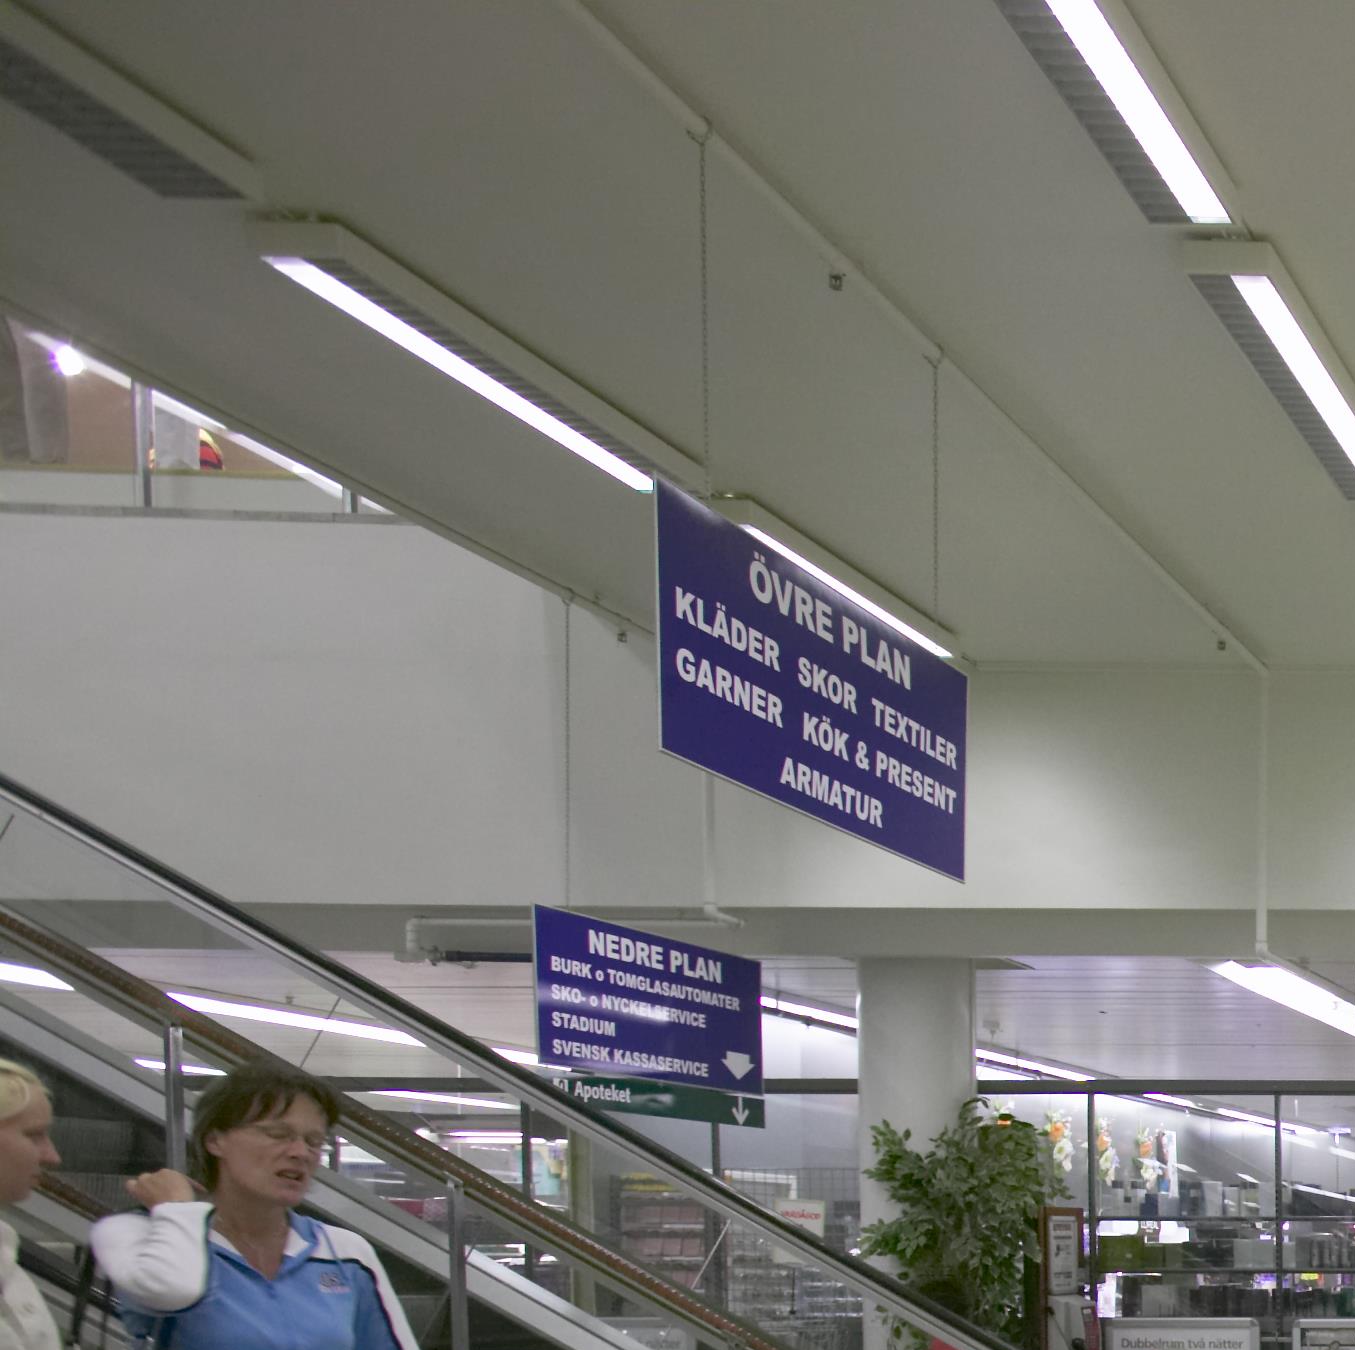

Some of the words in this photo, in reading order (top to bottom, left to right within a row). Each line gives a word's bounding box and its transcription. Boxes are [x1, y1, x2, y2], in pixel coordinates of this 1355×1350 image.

[750, 552, 834, 644] ÖVRE
[842, 616, 912, 690] PLAN
[675, 586, 781, 672] KLÄDER
[798, 657, 858, 714] SKOR
[871, 697, 957, 770] TEXTILER
[675, 647, 783, 728] GARNER
[803, 711, 849, 763] KÖK
[855, 741, 870, 770] &
[876, 751, 957, 815] PRESENT
[780, 757, 883, 829] ARMATUR
[551, 955, 592, 980] BURK
[607, 969, 740, 1011] TOMGLASAUTOMATER
[588, 929, 664, 971] NEDRE
[669, 951, 722, 984] PLAN
[551, 984, 586, 1004] SKO-
[602, 995, 707, 1028] NYCKELSERVICE
[552, 1011, 616, 1037] STADIUM
[552, 1039, 610, 1062] SVENSK
[614, 1049, 709, 1077] KASSASERVICE
[574, 1080, 631, 1103] Apoteket
[1121, 1338, 1185, 1349] Dubbelrum
[1188, 1338, 1206, 1349] två
[1208, 1339, 1243, 1349] nätter
